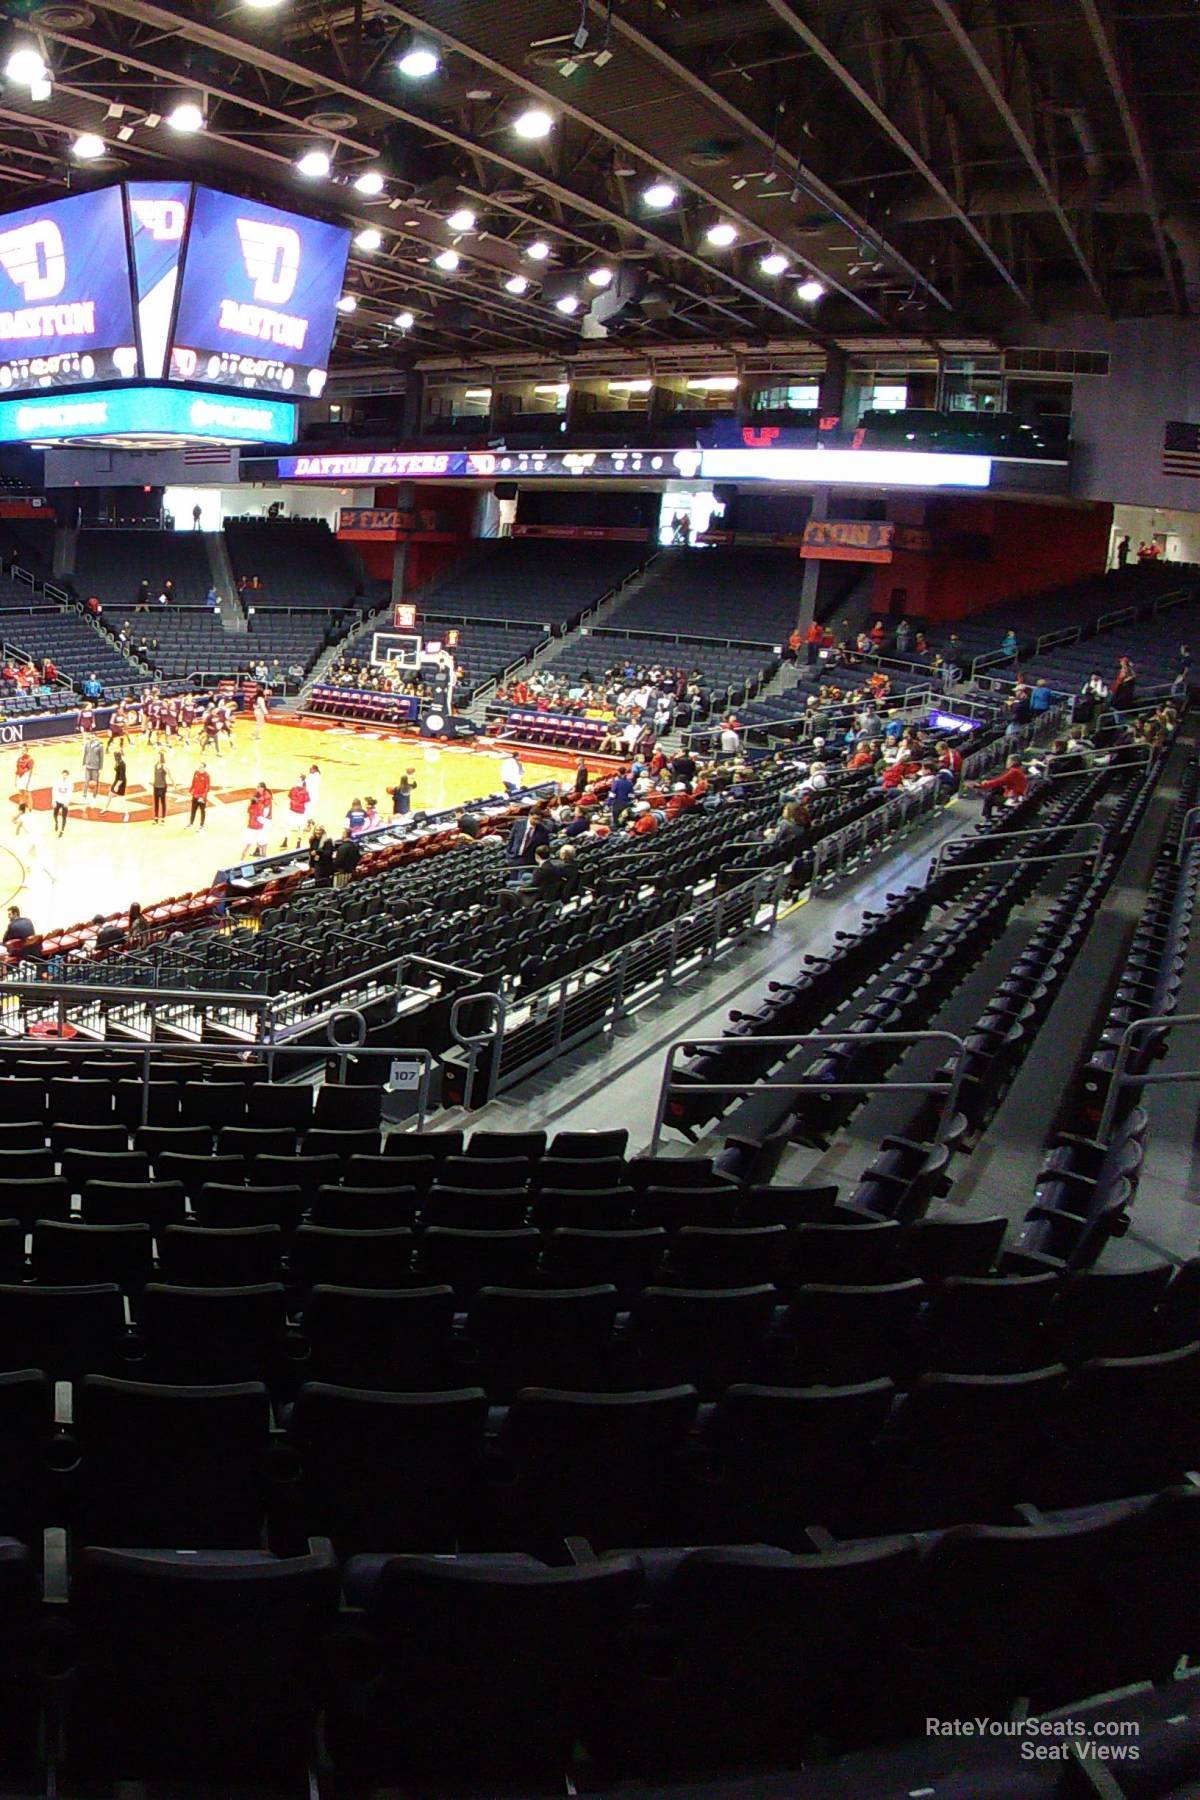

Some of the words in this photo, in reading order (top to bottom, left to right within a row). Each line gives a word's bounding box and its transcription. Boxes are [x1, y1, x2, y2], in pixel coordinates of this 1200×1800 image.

[219, 299, 308, 350] DAYTON
[295, 457, 370, 475] DAYTON
[371, 455, 449, 474] FLYERS
[395, 1071, 416, 1081] 107
